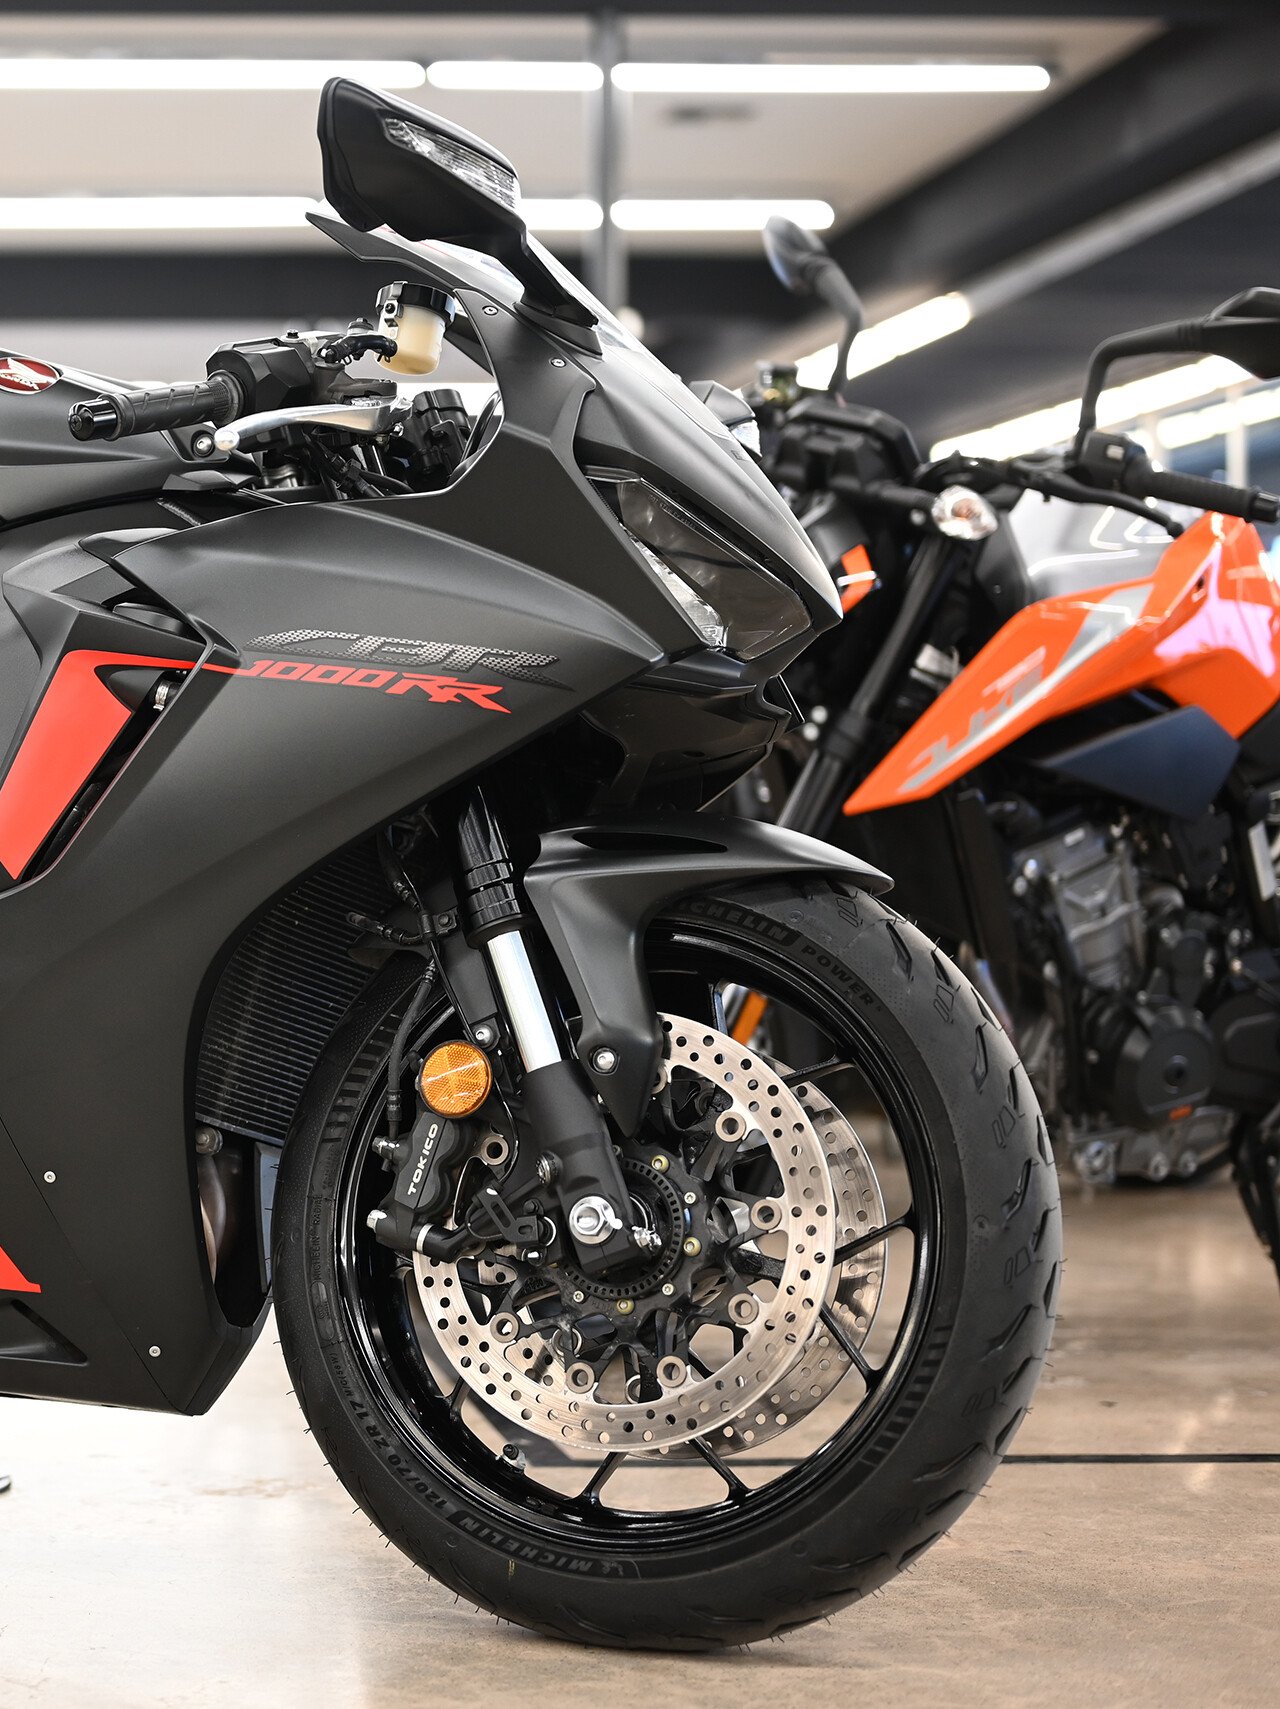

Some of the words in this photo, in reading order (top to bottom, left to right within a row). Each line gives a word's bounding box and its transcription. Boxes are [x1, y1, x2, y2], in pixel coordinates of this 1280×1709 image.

[244, 629, 575, 692] CBR
[407, 1123, 439, 1196] TOKICO
[349, 1400, 370, 1420] 17
[365, 1424, 391, 1450] ZR
[387, 1454, 448, 1510] 120/70
[458, 1515, 594, 1574] MICHELIN
